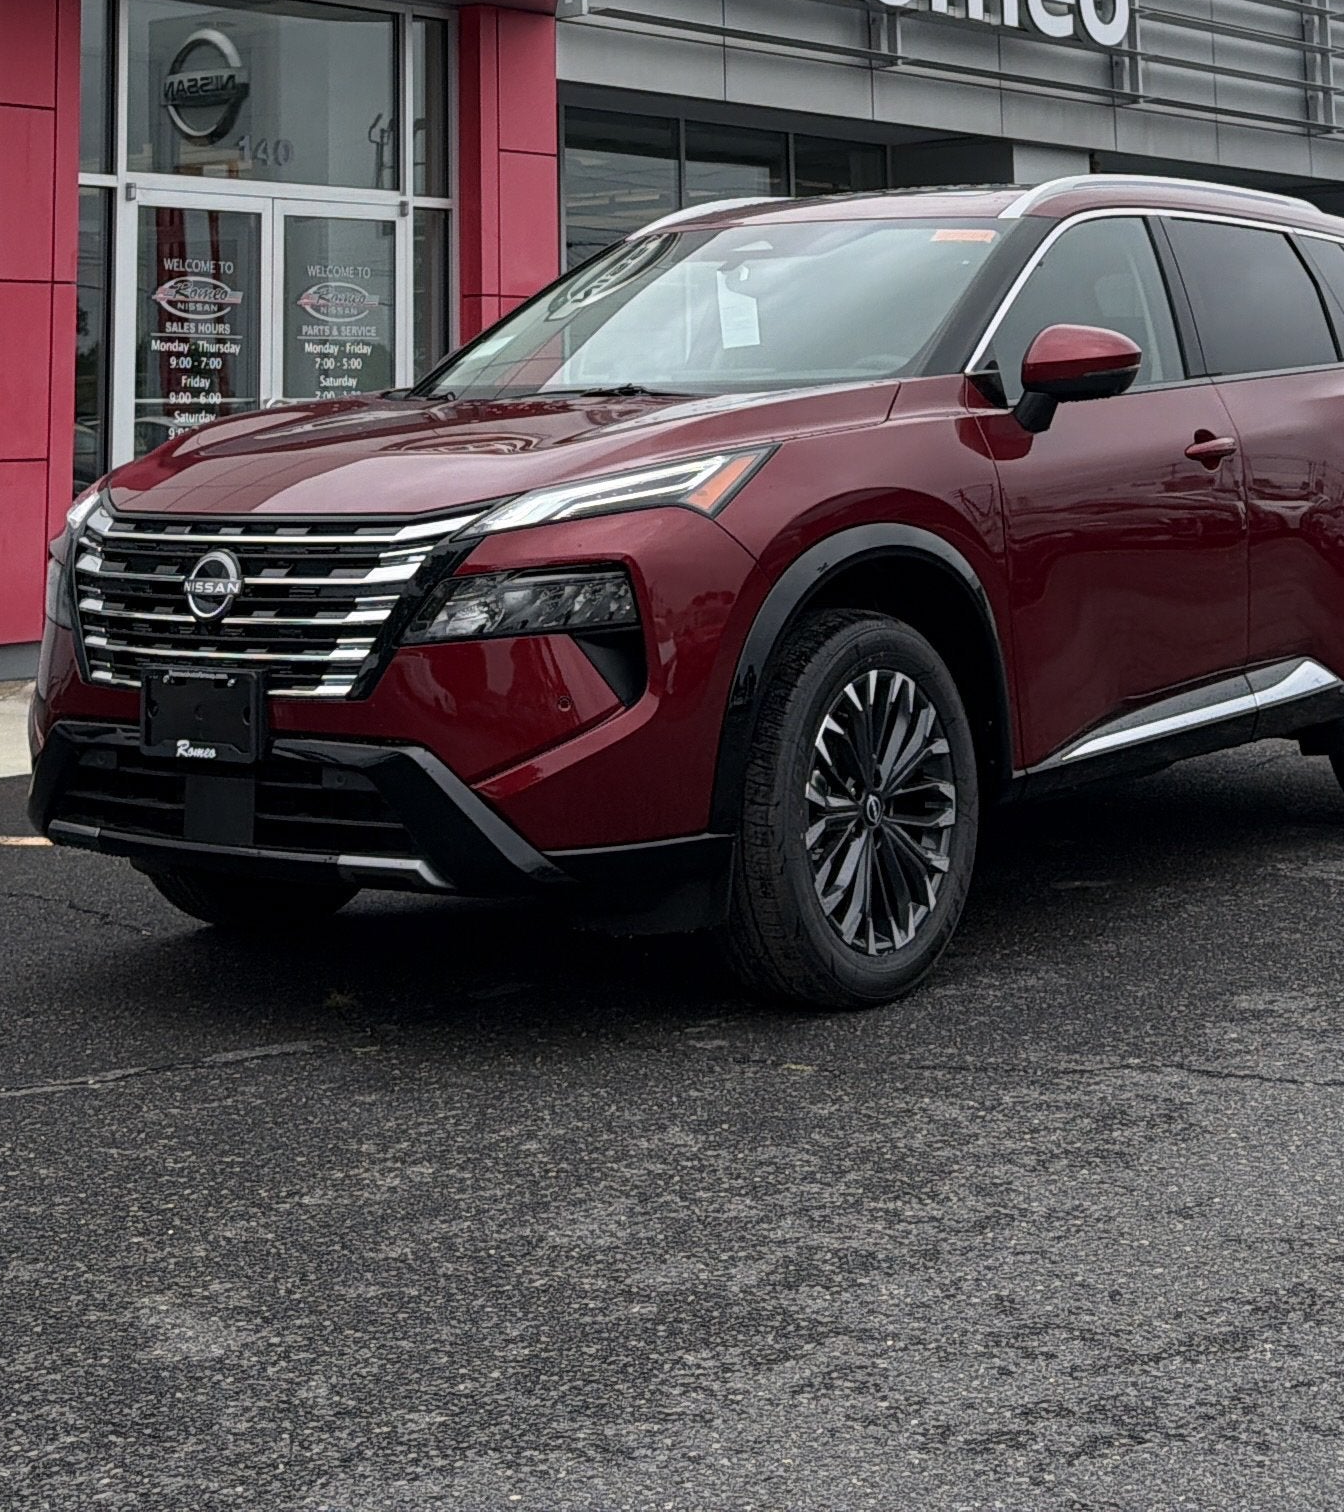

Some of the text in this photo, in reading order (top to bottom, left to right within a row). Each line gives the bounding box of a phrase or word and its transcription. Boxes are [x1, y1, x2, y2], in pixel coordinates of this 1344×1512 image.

[163, 257, 234, 275] WELCOME TO
[307, 265, 371, 278] WELCOME TO
[176, 302, 218, 312] NISSAN
[320, 307, 358, 315] NISSAN
[165, 321, 231, 335] SALES HOURS
[301, 325, 377, 337] PARTS & SERVICE
[151, 339, 190, 355] Monday
[196, 341, 241, 357] Thursday
[304, 342, 339, 356] Monday
[345, 343, 372, 356] Friday
[169, 356, 193, 369] 9:00
[200, 357, 223, 369] 7:00
[314, 358, 335, 370] 7:00
[342, 358, 363, 370] 5:00
[181, 375, 211, 390] Friday
[319, 375, 358, 388] Saturday
[169, 392, 192, 405] 9:00
[199, 392, 222, 405] 6:00
[174, 409, 217, 424] Saturday
[184, 581, 240, 594] NISSAN
[176, 739, 216, 759] Romeo
